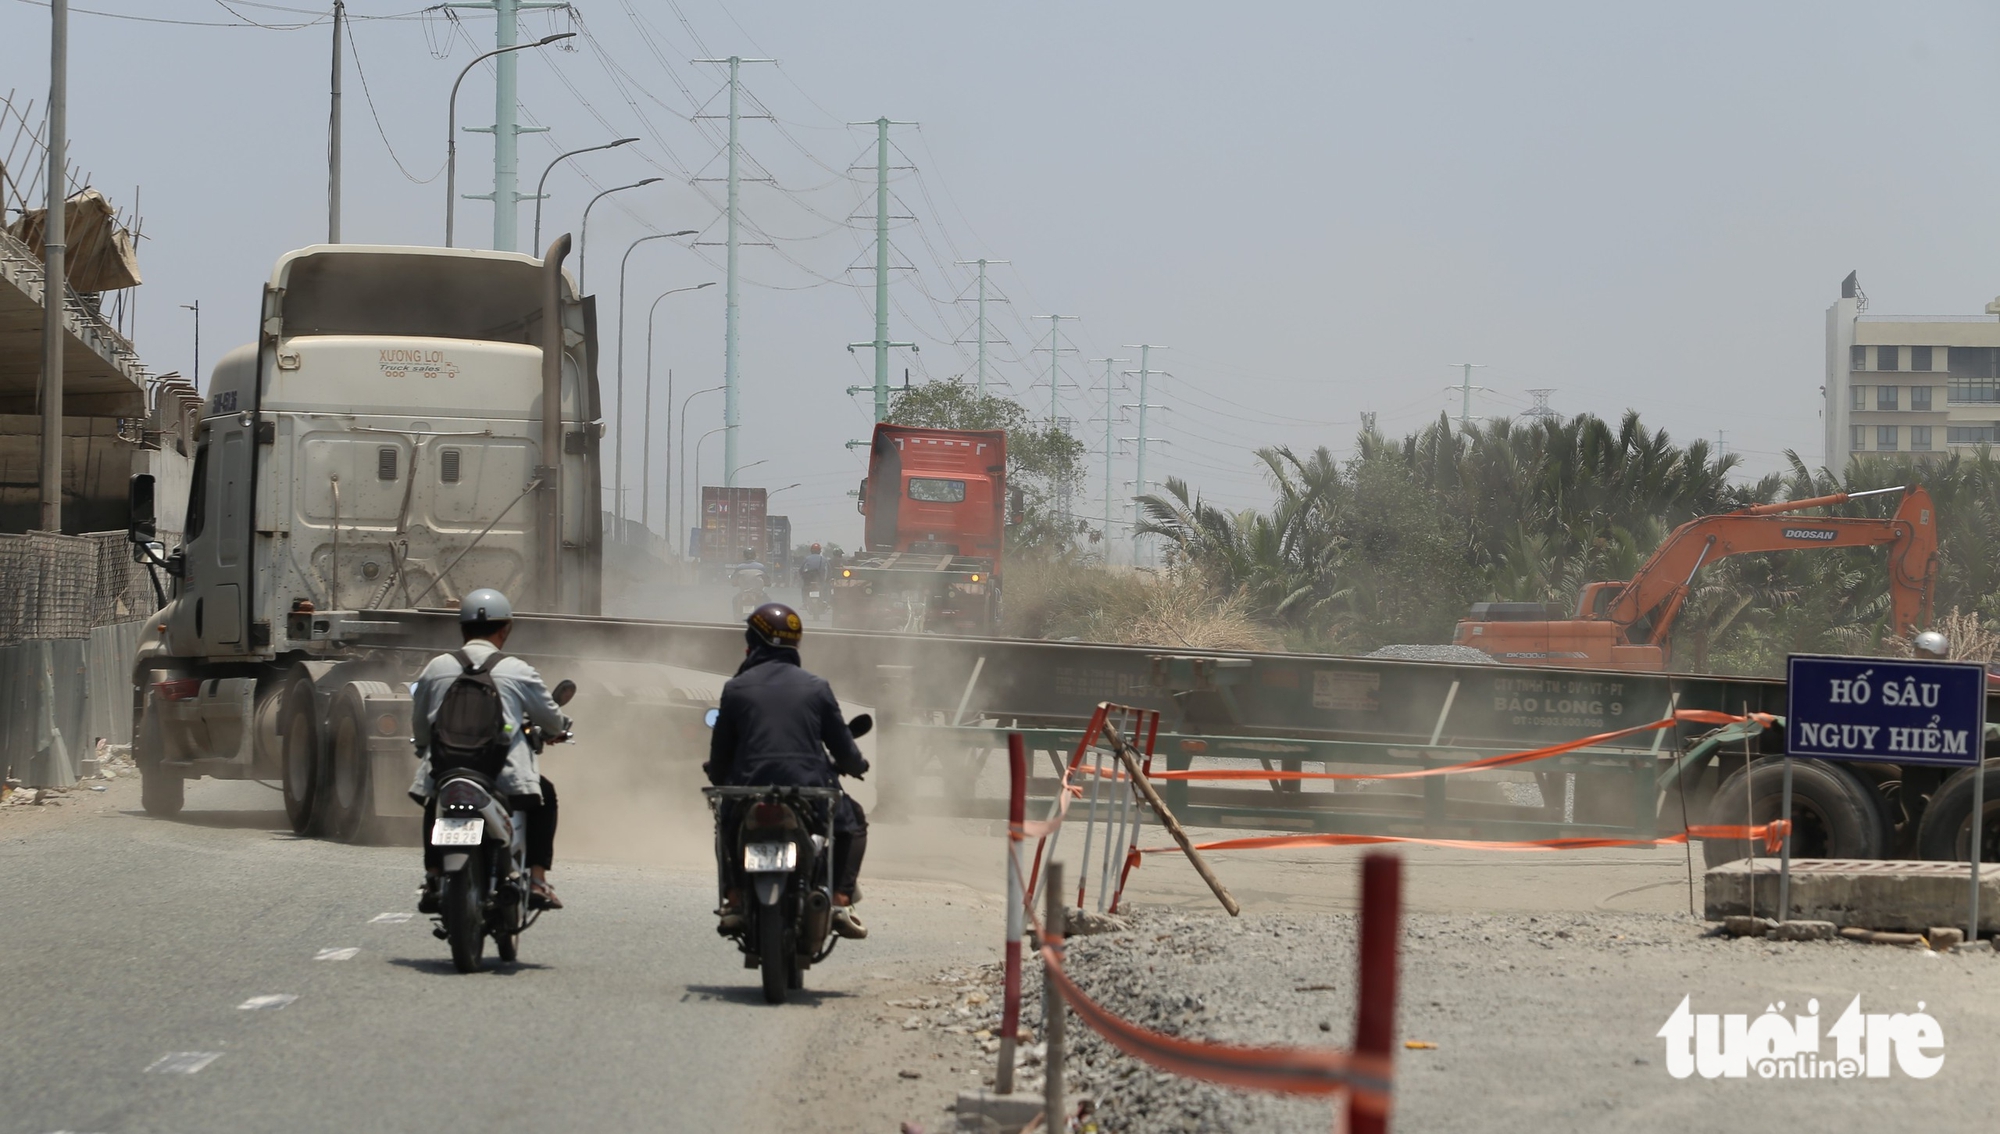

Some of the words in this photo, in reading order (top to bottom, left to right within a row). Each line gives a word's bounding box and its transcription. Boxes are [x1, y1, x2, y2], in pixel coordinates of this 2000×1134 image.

[1785, 529, 1834, 540] DOOSAN
[1829, 669, 1874, 704] HỐ
[1882, 675, 1941, 707] SÂU
[1545, 698, 1604, 715] LONG
[1610, 702, 1623, 716] 9
[1800, 722, 1880, 750] NGUY
[1889, 714, 1968, 754] HIỂM
